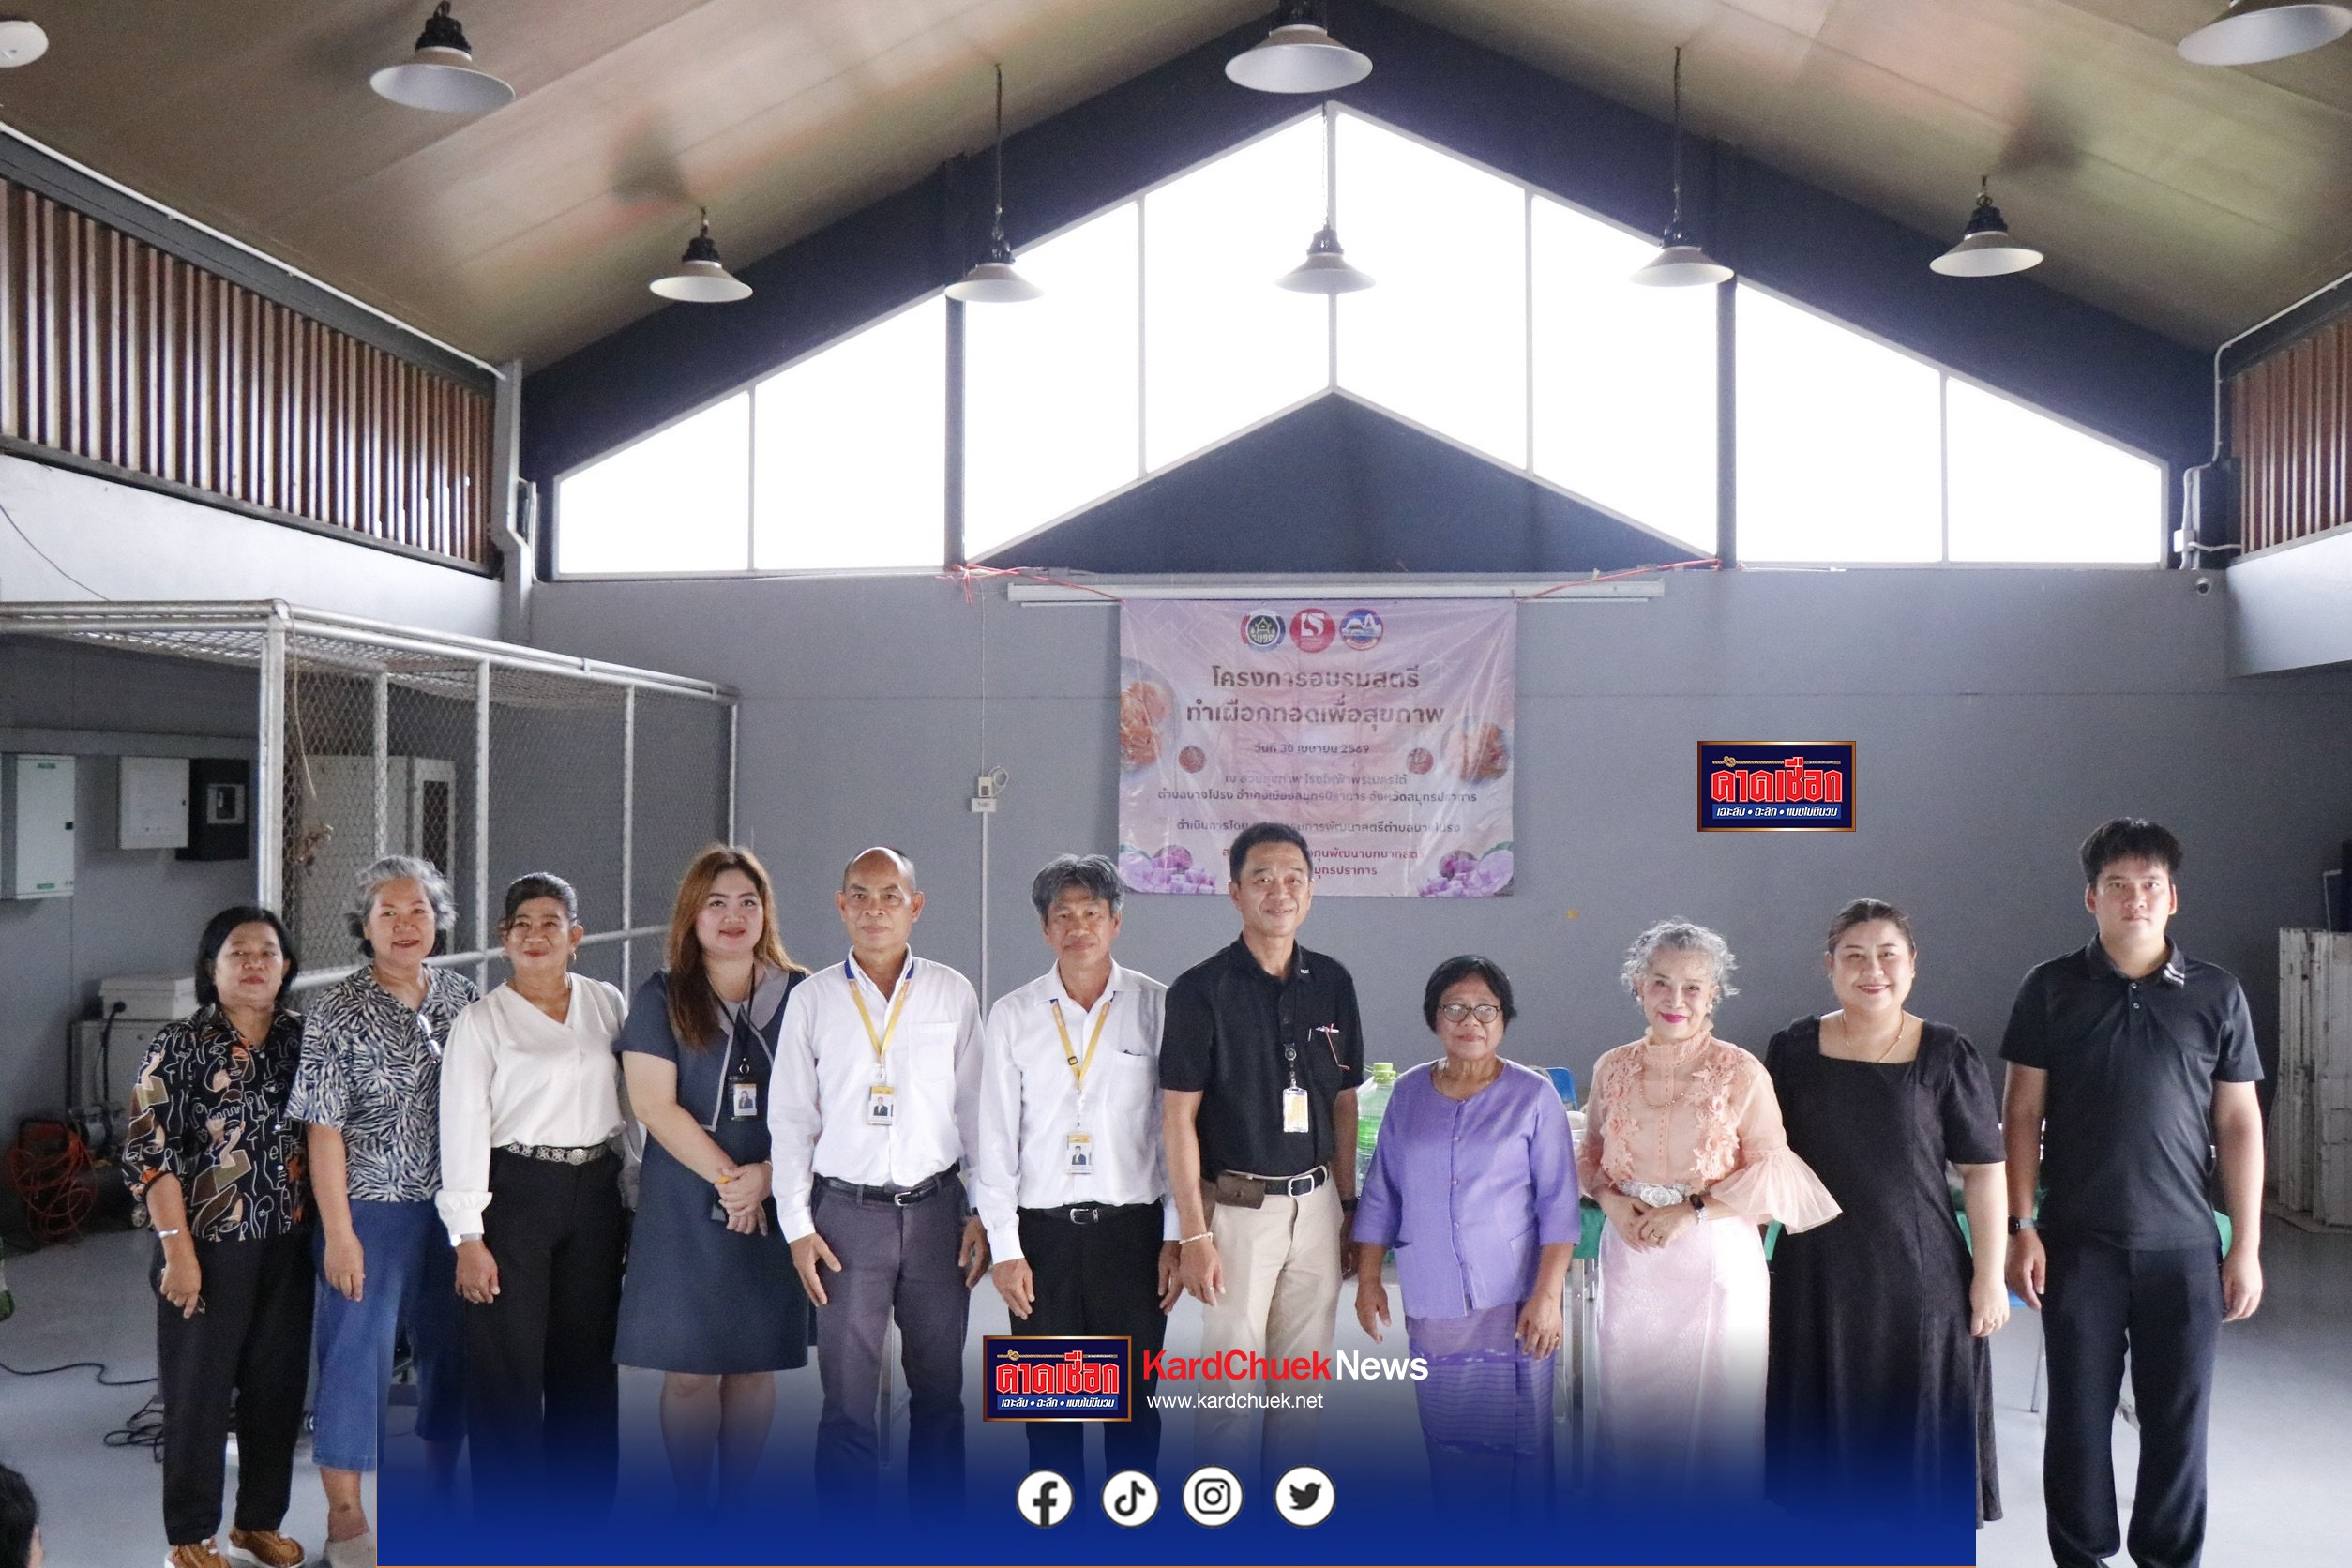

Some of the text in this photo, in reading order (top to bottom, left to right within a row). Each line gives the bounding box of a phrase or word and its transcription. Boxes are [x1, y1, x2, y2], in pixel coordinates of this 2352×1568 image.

[1212, 664, 1420, 688] โครงการอบรมสตรี
[1187, 694, 1444, 731] ทำเผือกทอดเพื่อสุขภาพ
